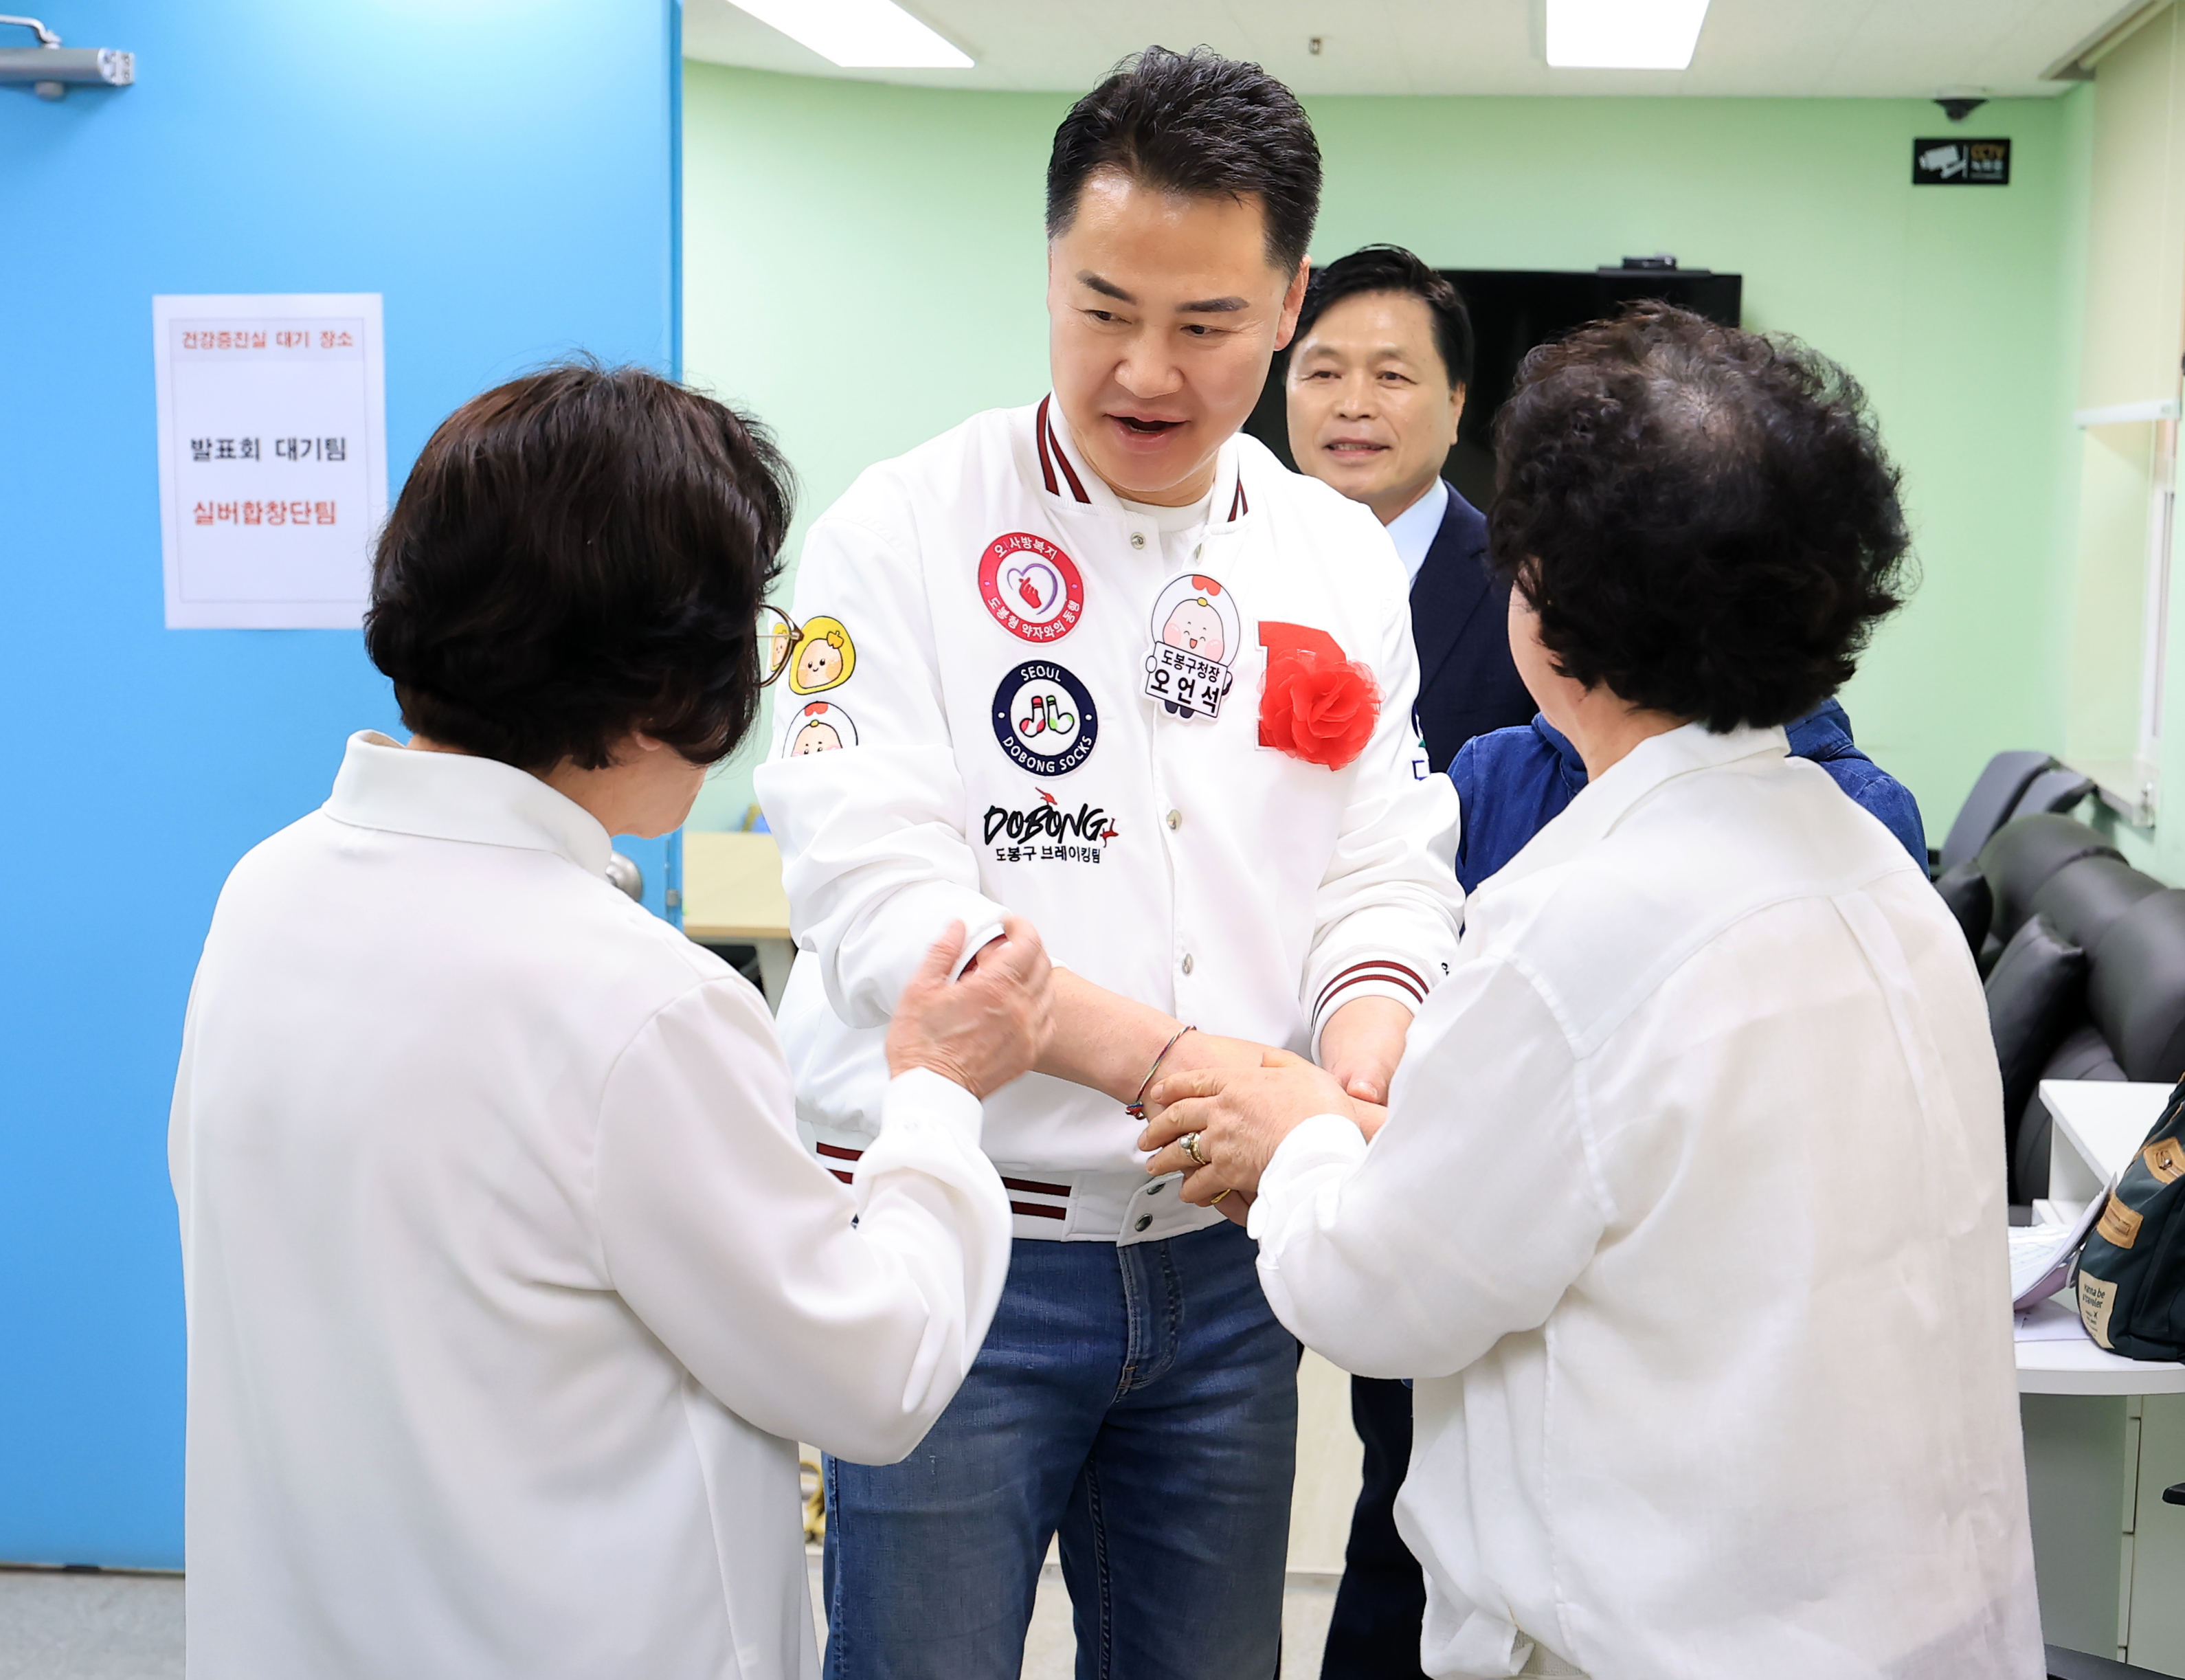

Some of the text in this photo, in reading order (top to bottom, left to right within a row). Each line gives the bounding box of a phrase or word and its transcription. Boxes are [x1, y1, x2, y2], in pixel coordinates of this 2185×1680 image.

[182, 331, 354, 349] 건강증진실 대기 장소
[190, 437, 346, 462] 발표회 대기팀
[194, 500, 337, 526] 실버합창단팀
[987, 597, 1080, 640] 도봉형 약자와의 동행
[1020, 665, 1062, 682] SEOUL
[1161, 649, 1220, 683] 도봉구청장
[1002, 735, 1092, 773] DOBONG SOCKS
[983, 803, 1108, 845] DOBONG
[996, 845, 1101, 864] 도봉구 브레이킹팀
[2097, 1288, 2105, 1299] be
